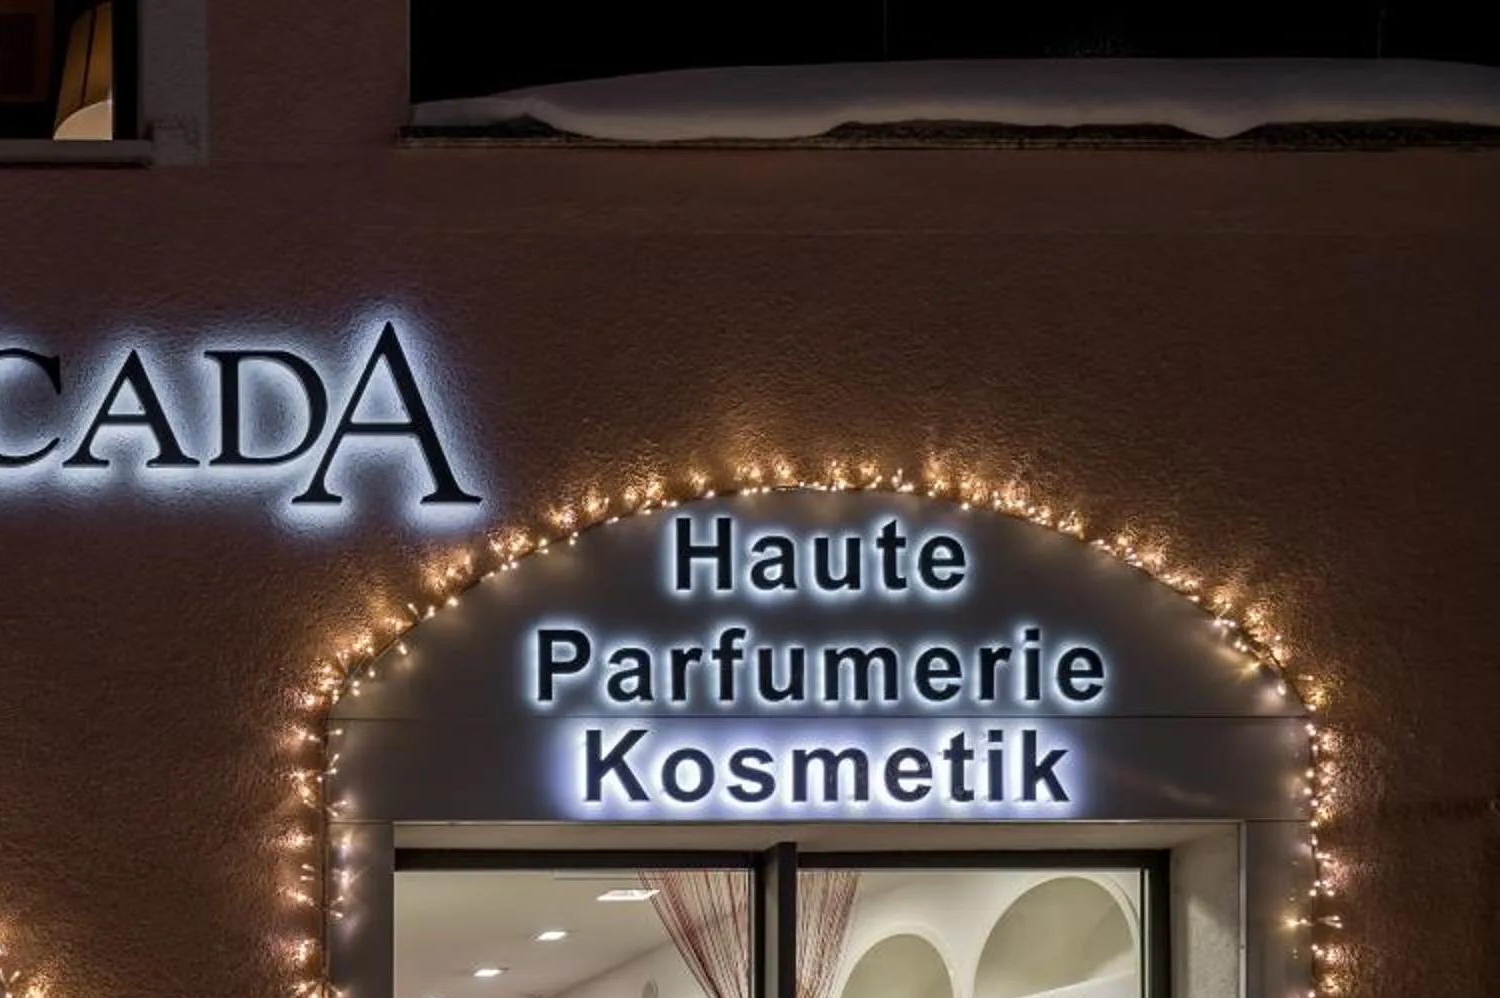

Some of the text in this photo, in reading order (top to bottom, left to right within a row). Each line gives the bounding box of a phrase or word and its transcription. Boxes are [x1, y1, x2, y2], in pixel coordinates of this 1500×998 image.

[675, 517, 966, 590] Haute
[537, 628, 1105, 702] Parfumerie
[585, 729, 1071, 803] Kosmetik
